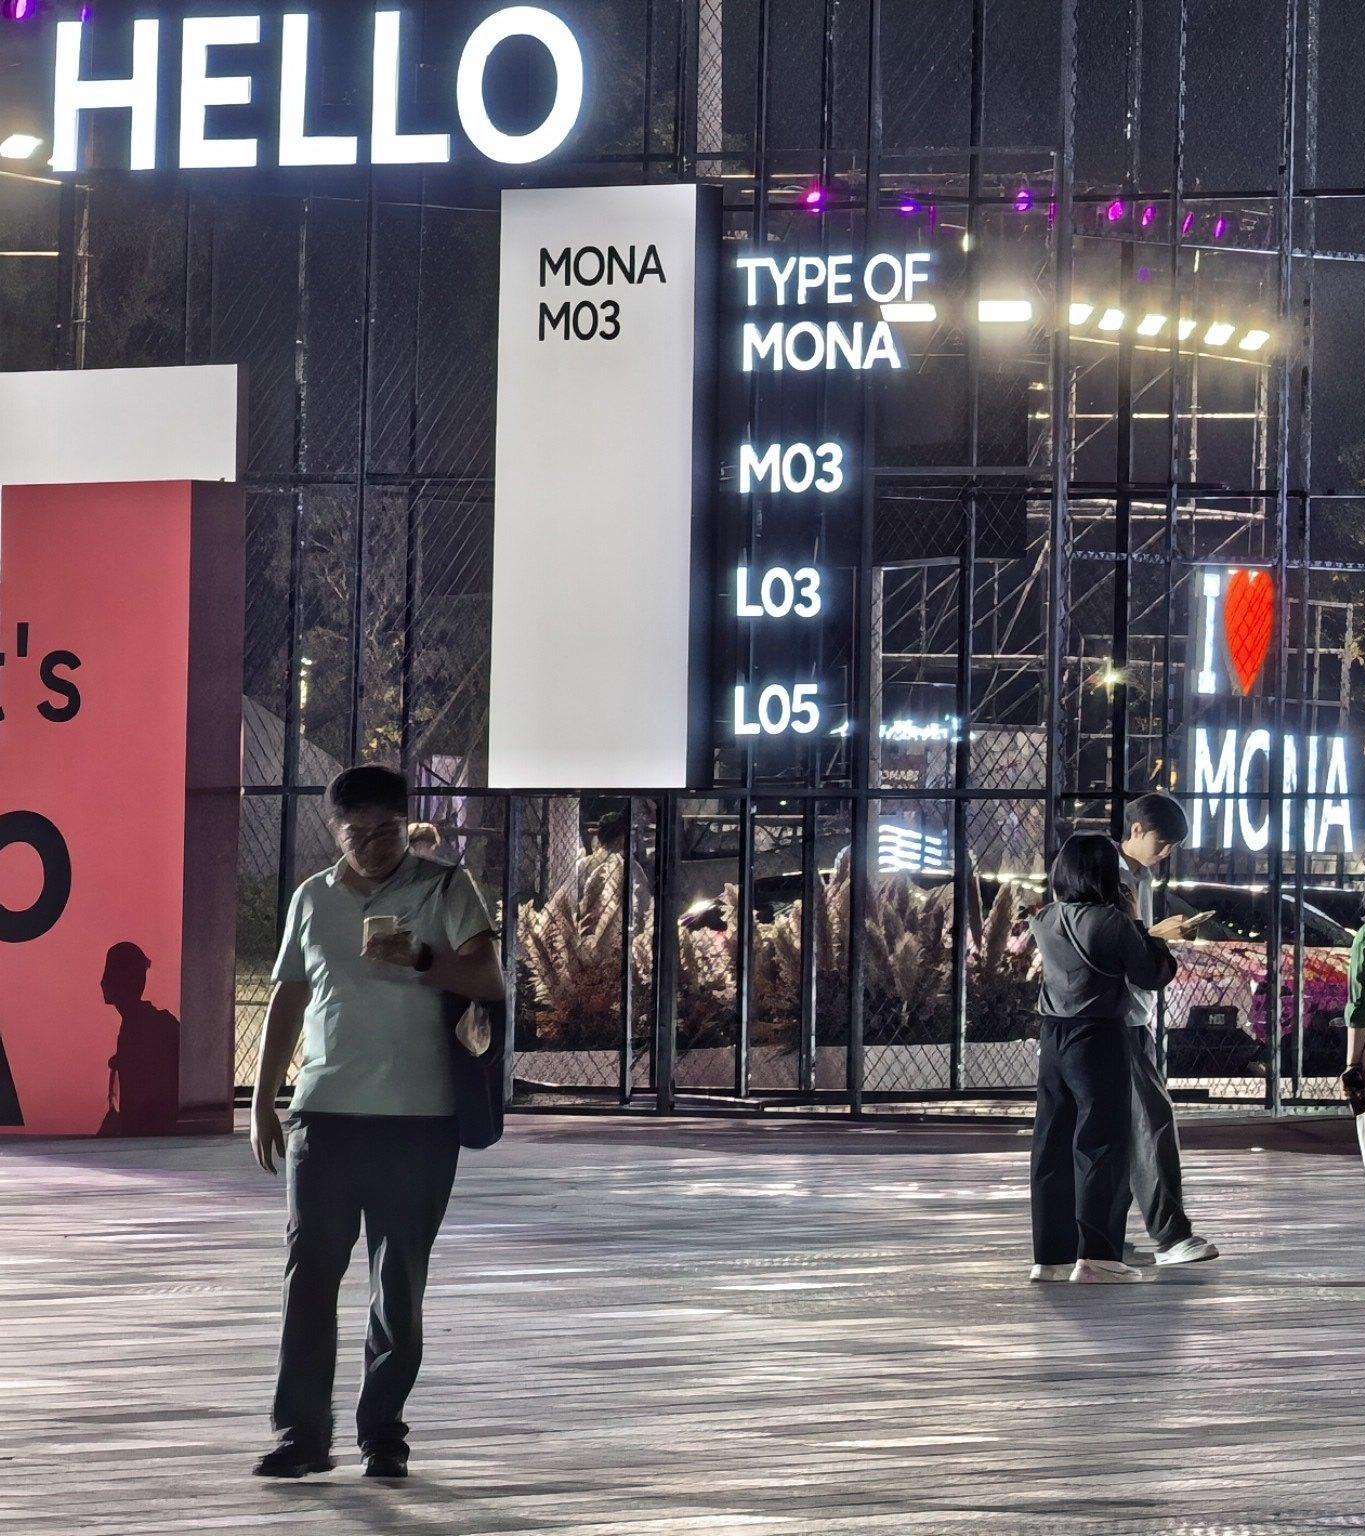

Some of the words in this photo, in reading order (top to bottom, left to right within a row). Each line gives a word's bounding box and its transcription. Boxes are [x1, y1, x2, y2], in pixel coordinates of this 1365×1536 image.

[54, 5, 584, 173] HELLO
[539, 244, 667, 288] MONA
[736, 254, 853, 306] TYPE
[863, 252, 931, 303] OF
[538, 299, 621, 342] M03
[742, 321, 902, 372] MONA
[739, 442, 843, 495] M03
[736, 567, 821, 618] L03
[0, 621, 82, 723] 's
[734, 683, 820, 735] L05
